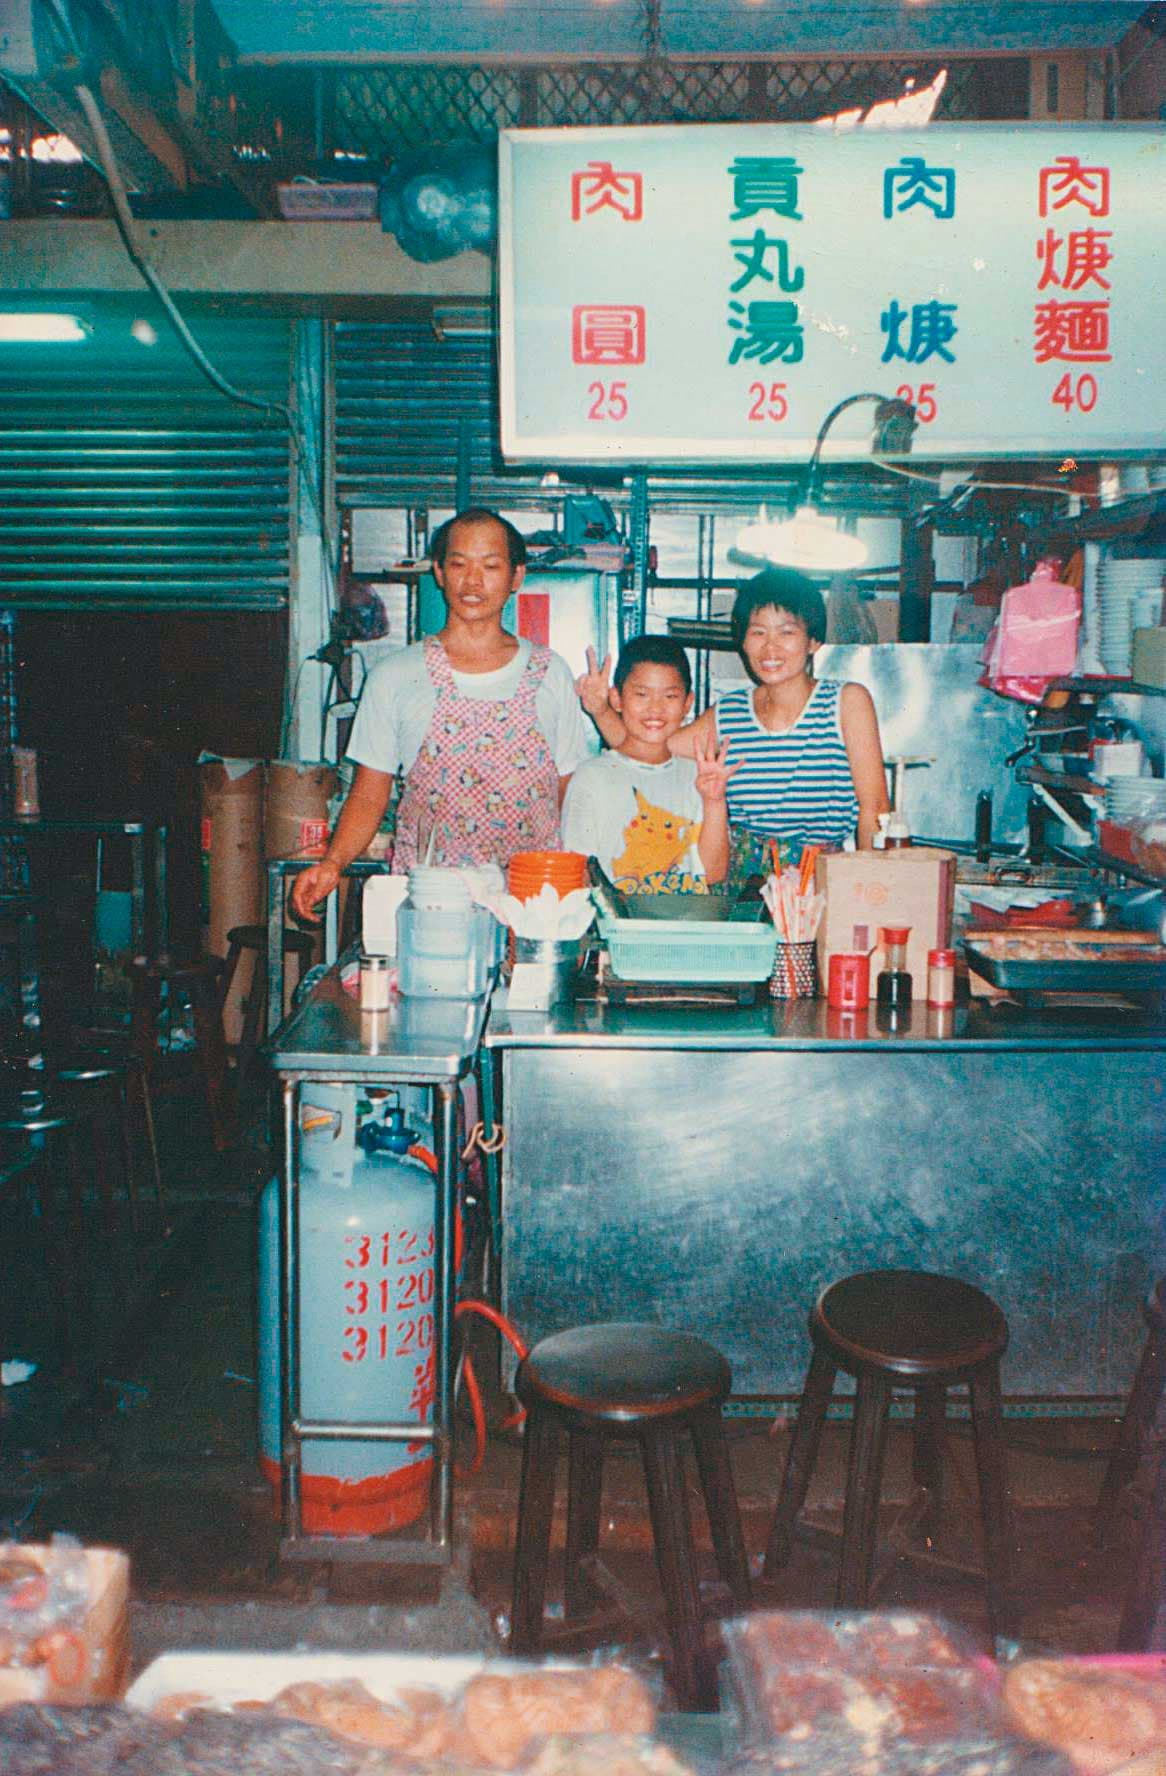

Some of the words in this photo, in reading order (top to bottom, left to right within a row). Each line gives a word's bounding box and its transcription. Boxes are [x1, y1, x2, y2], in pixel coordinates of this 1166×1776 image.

[570, 160, 647, 366] 肉圓
[726, 156, 806, 366] 貢丸湯
[587, 381, 629, 422] 25
[747, 381, 790, 423] 25
[896, 383, 938, 424] 25
[1051, 372, 1098, 413] 40
[343, 1268, 435, 1315] 3120
[341, 1313, 435, 1362] 3120
